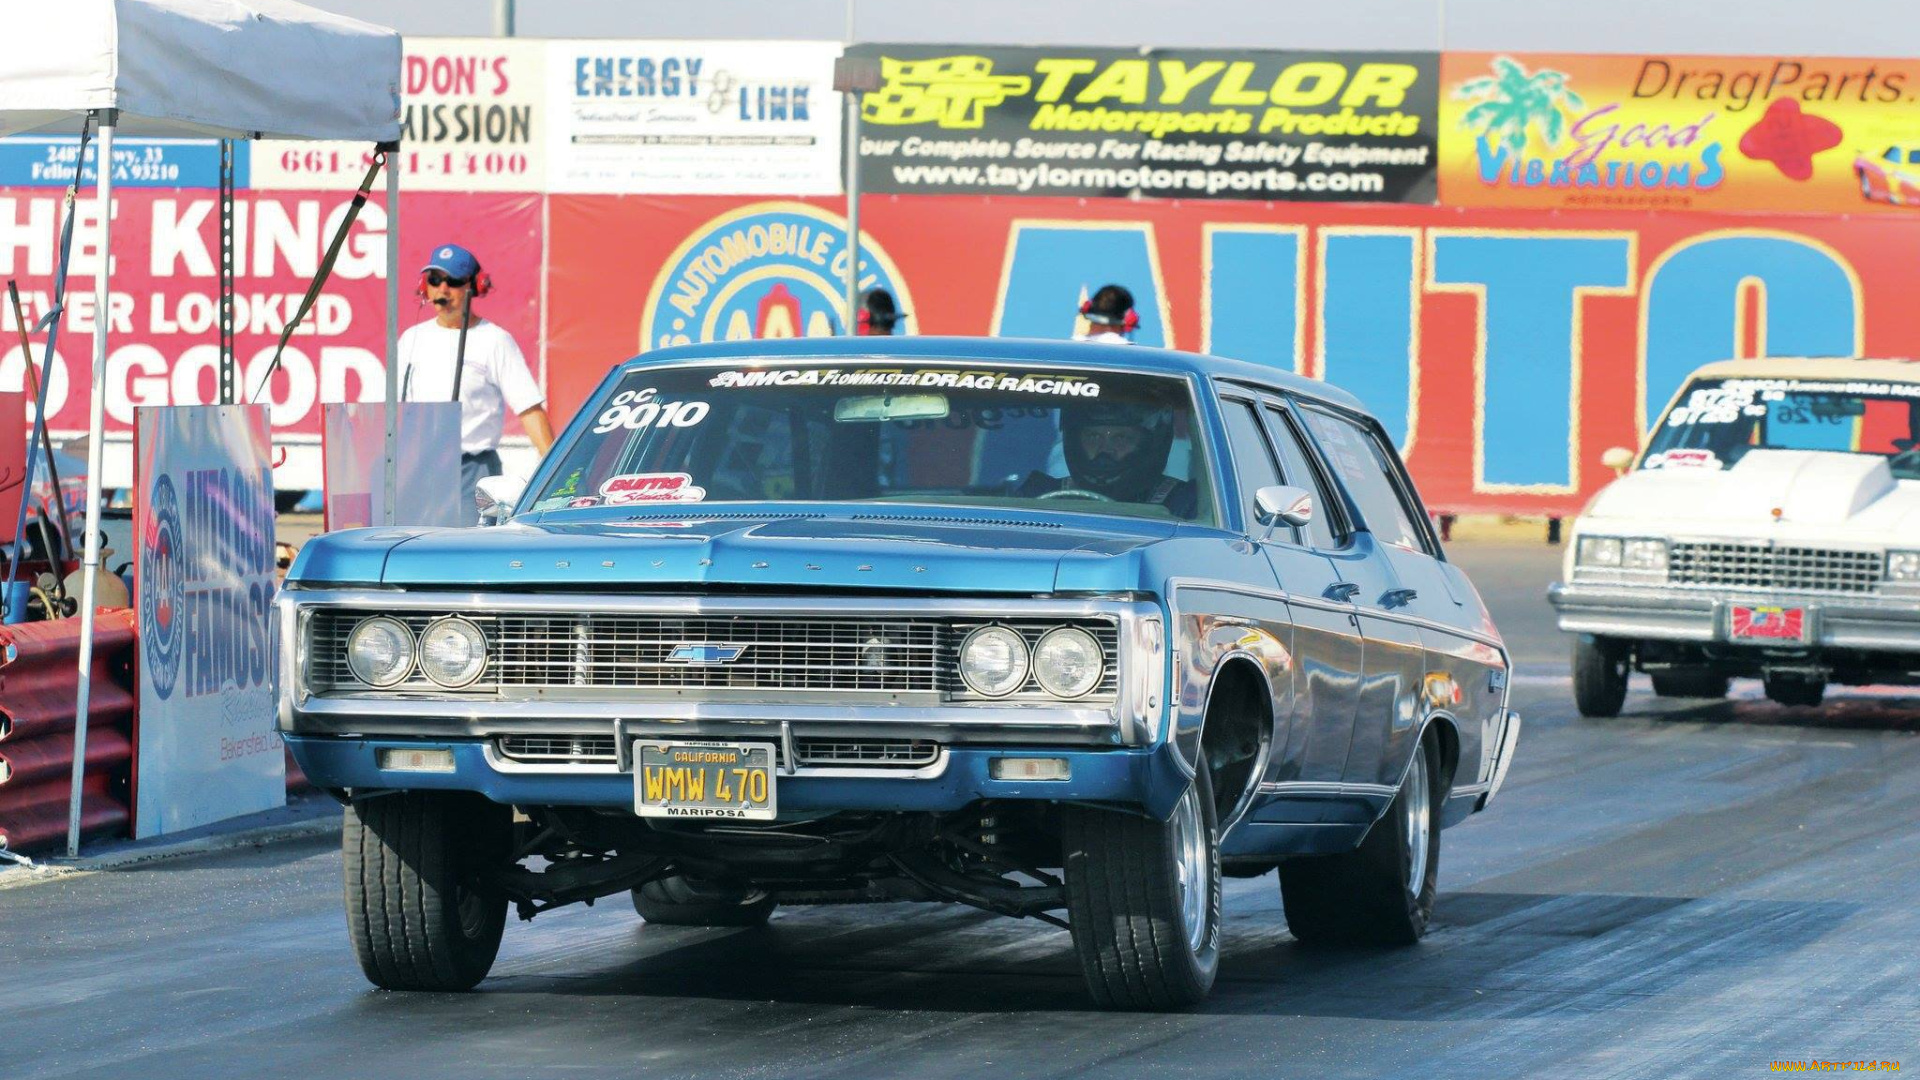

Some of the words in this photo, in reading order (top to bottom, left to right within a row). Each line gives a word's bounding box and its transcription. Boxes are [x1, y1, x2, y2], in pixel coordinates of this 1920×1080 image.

[576, 57, 703, 96] ENERGY
[1034, 60, 1419, 107] TAYLOR
[740, 87, 810, 121] LINK
[1029, 103, 1253, 138] Motorsports
[1259, 107, 1420, 136] Products
[859, 137, 900, 157] our
[901, 137, 1011, 160] Complete
[1013, 138, 1097, 160] Source
[1098, 138, 1141, 160] For
[1141, 140, 1223, 165] Racing
[1224, 141, 1302, 167] Safety
[1302, 142, 1429, 168] Equipment
[1563, 103, 1715, 169] Good
[892, 163, 1384, 195] www.taylormotorsports.com
[150, 199, 387, 279] KING
[669, 222, 835, 318] AUTOMOBILE
[150, 292, 352, 336] LOOKED
[105, 344, 386, 426] GOOD
[917, 372, 996, 390] DRAG
[998, 376, 1100, 398] RACING
[593, 400, 711, 434] 9010
[674, 751, 737, 763] CALIFORNIA
[645, 766, 705, 801] WMW
[715, 768, 768, 803] 470
[667, 808, 746, 818] MARIPOSA
